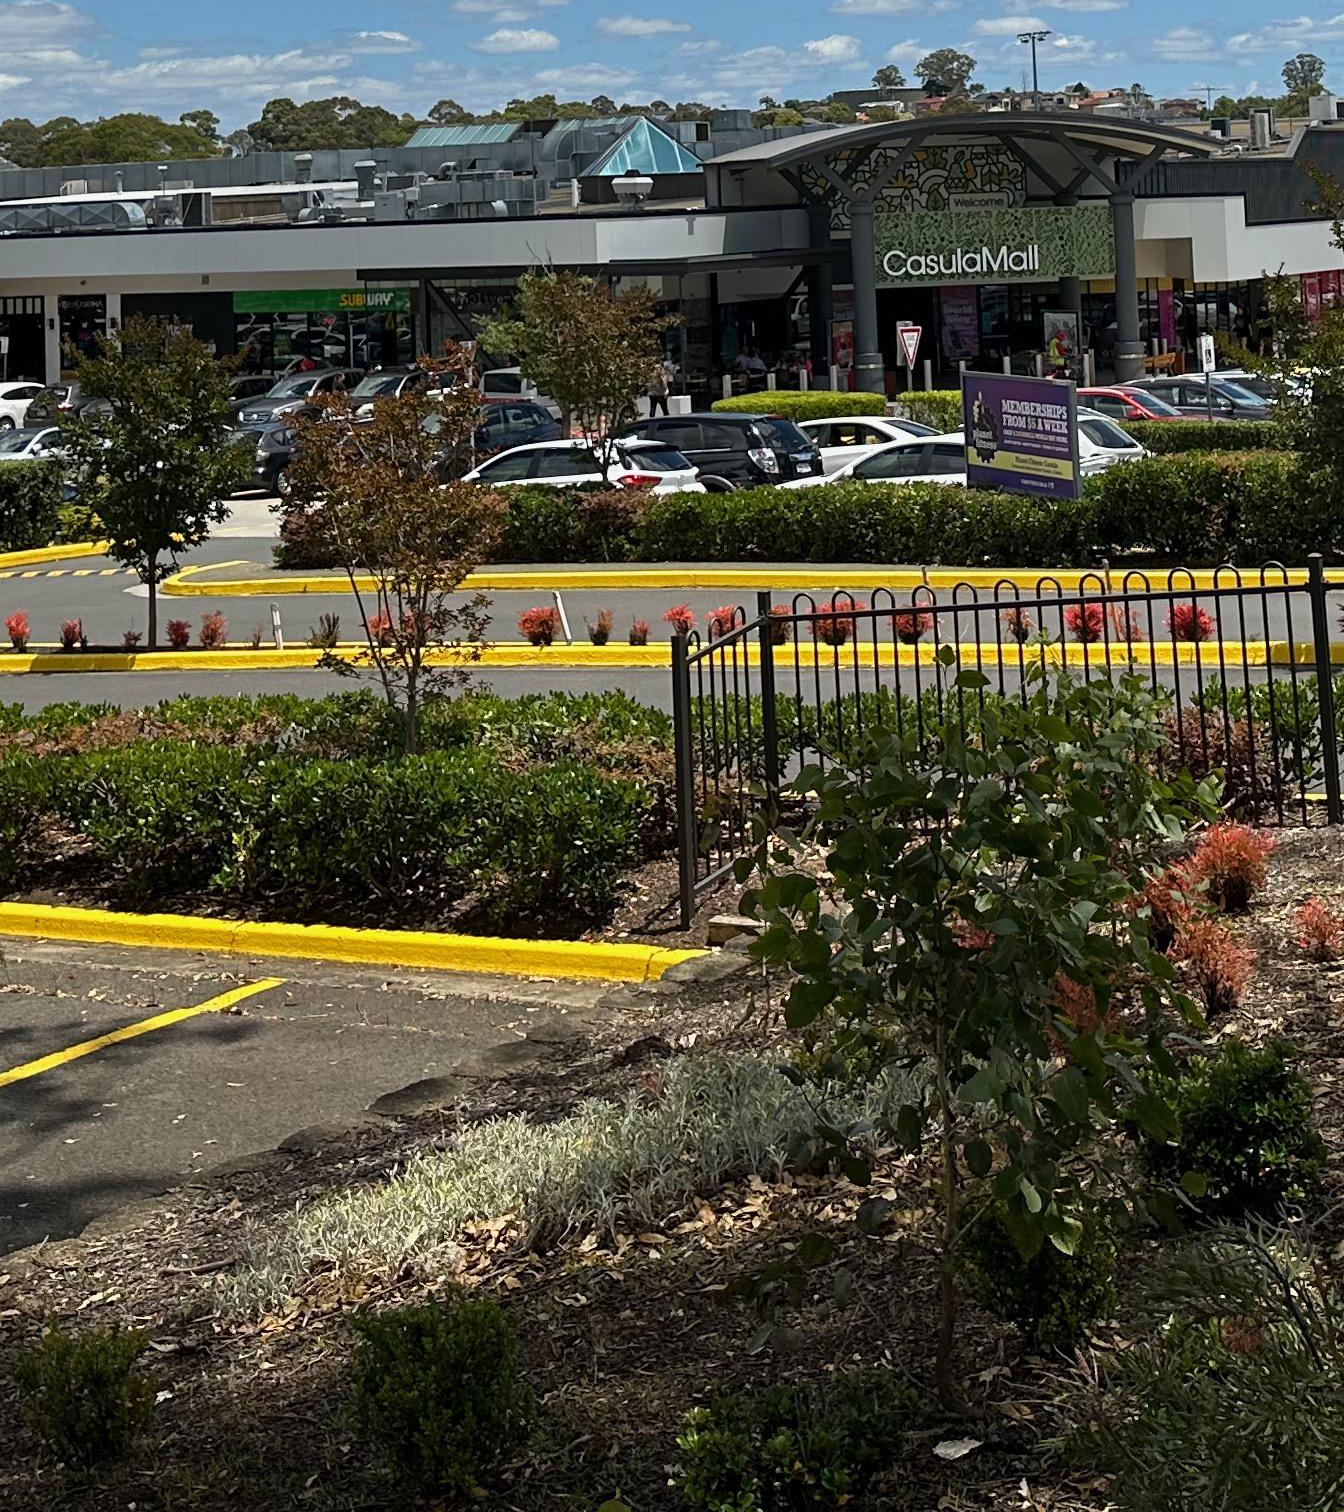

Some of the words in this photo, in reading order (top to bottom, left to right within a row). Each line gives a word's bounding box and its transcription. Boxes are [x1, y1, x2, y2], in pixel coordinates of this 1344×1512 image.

[954, 196, 1004, 208] Welcome
[883, 244, 1039, 276] CasulaMall
[339, 292, 394, 307] SUBWAY
[1001, 399, 1068, 420] MEMBERSHIPS
[1002, 414, 1027, 429] FROM
[1037, 418, 1044, 430] A
[1043, 419, 1068, 434] WEEK
